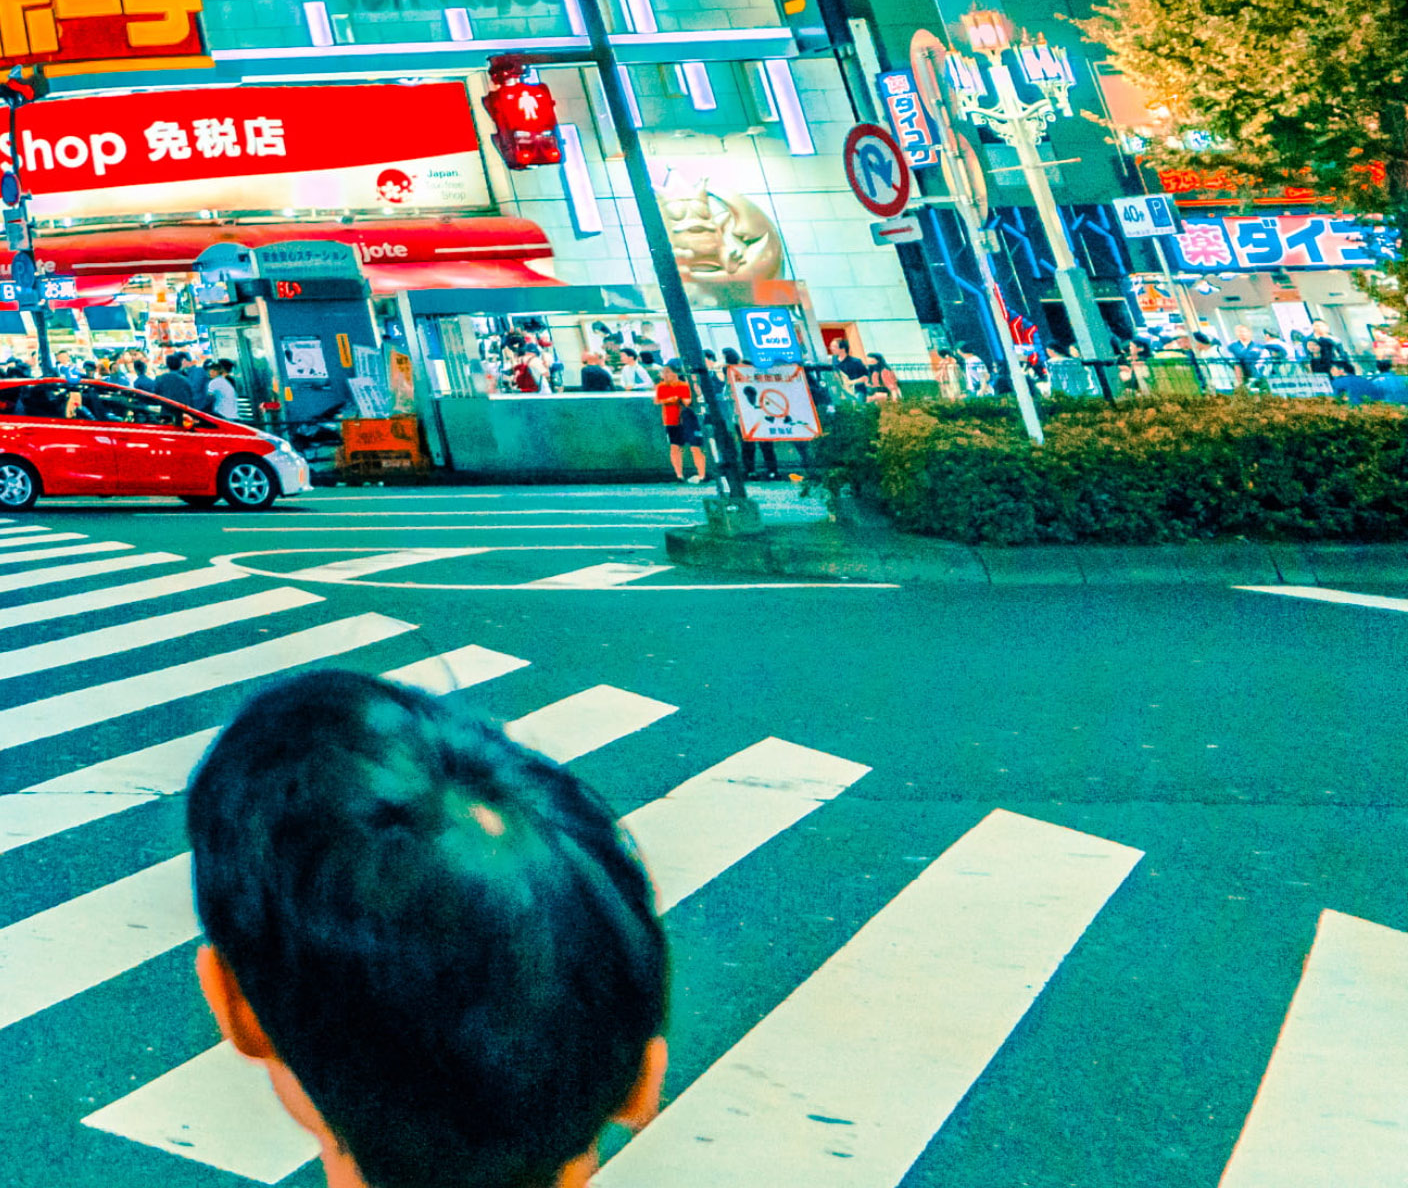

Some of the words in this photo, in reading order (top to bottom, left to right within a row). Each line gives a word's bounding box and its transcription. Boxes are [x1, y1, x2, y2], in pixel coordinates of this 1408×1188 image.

[143, 115, 287, 162] 免税店
[1181, 224, 1233, 265] 薬
[750, 317, 773, 345] P
